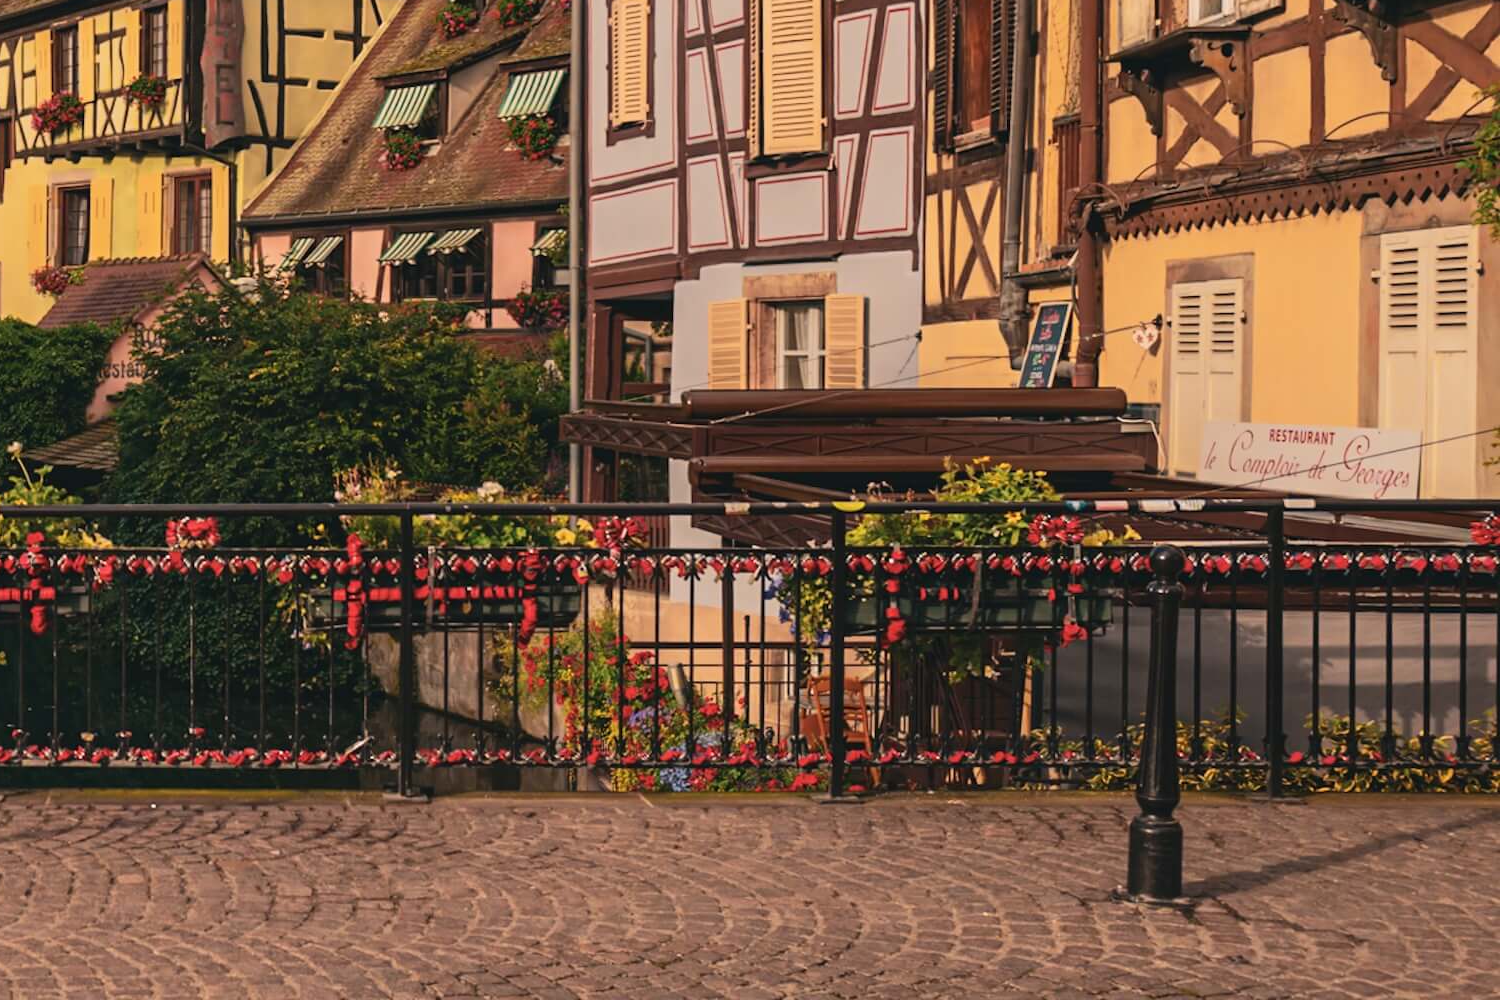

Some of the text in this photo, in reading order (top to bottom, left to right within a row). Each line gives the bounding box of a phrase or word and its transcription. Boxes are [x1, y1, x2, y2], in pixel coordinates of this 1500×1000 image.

[1268, 429, 1336, 446] RESTAURANT
[1228, 429, 1299, 489] Comptoir
[1308, 450, 1327, 480] de
[1336, 434, 1410, 500] Georges
